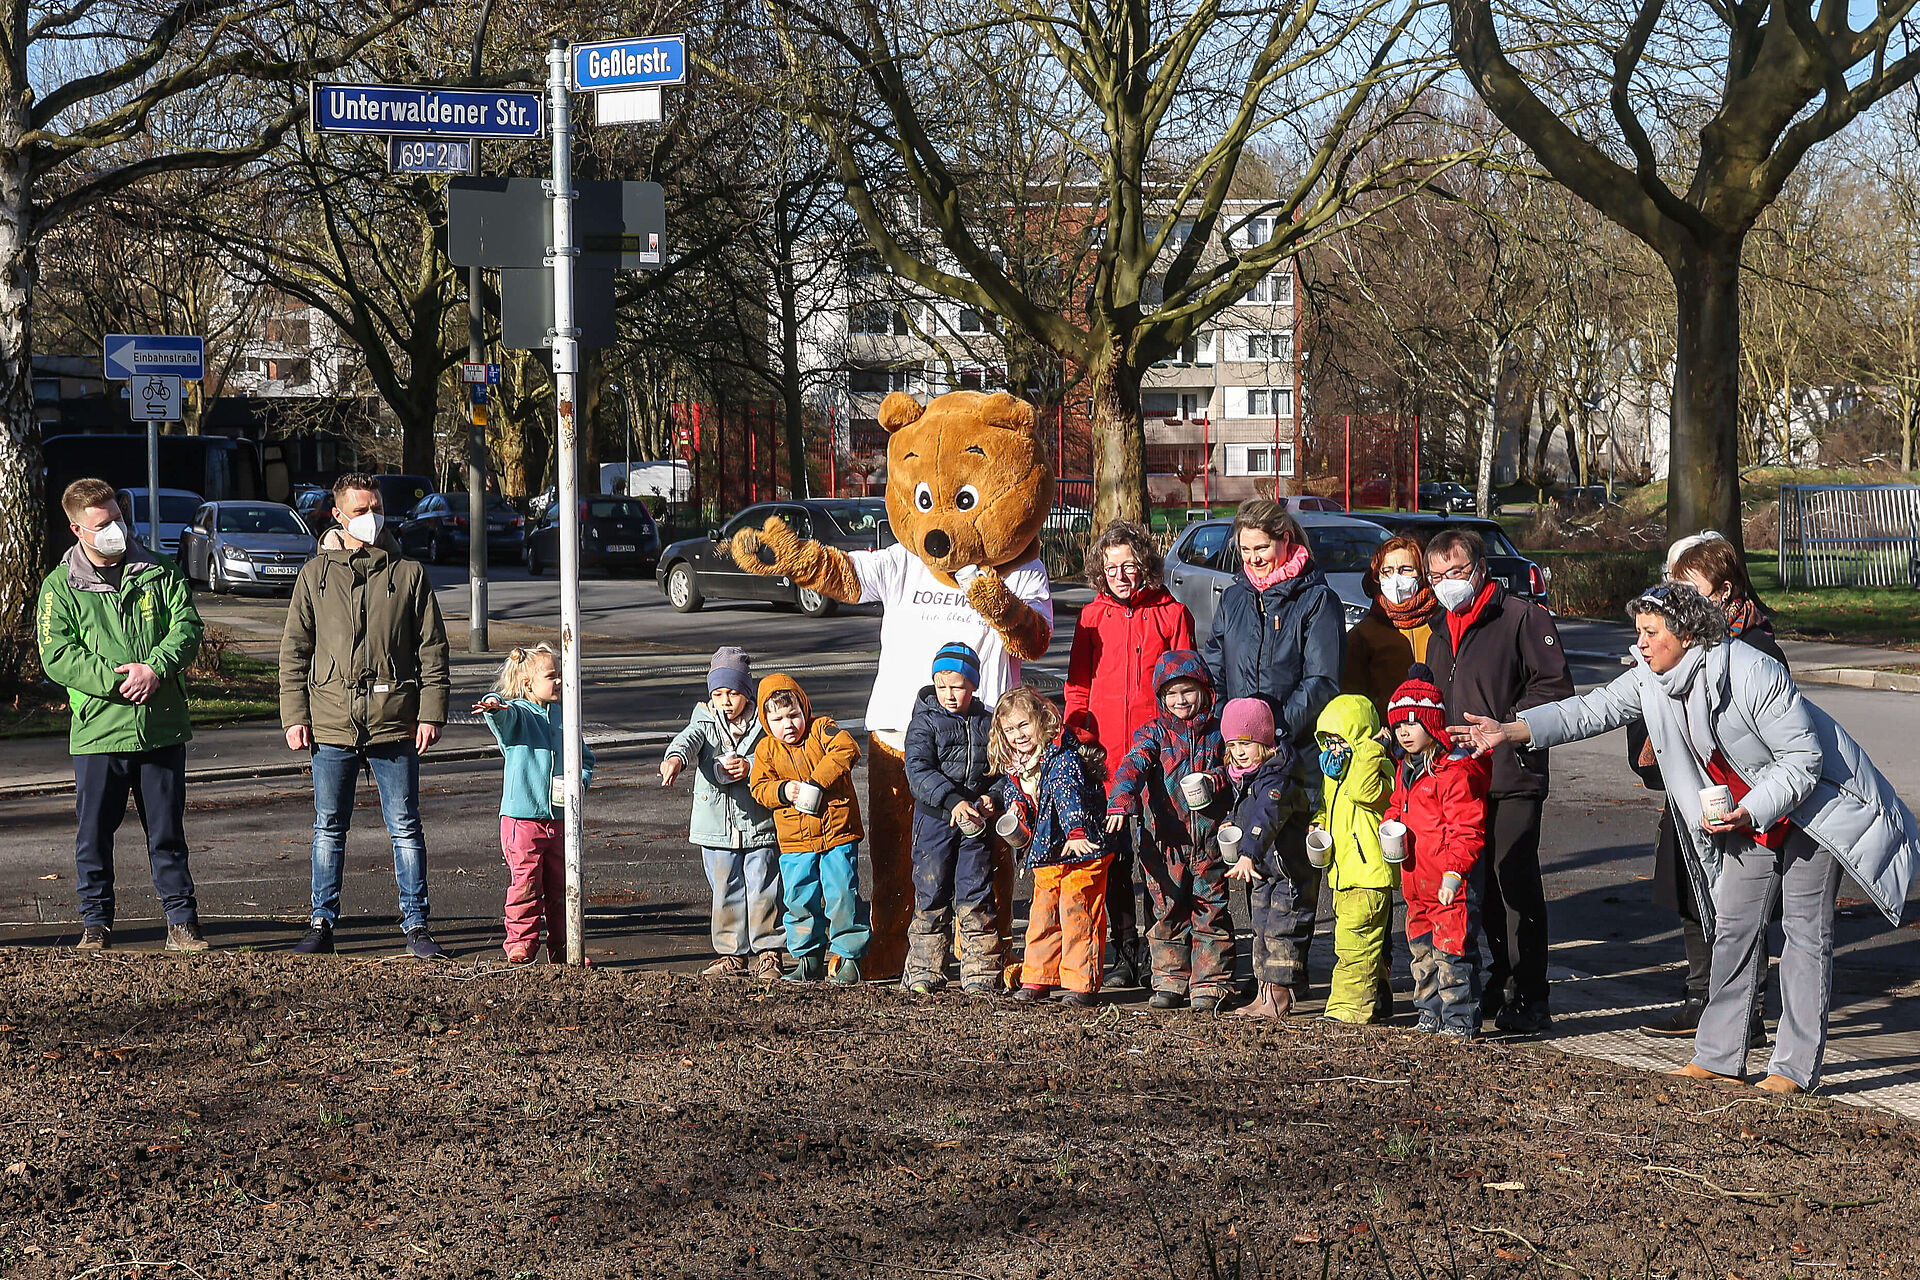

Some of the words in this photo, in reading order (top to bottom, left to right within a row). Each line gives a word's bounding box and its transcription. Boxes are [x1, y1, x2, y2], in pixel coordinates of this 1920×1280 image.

[588, 46, 672, 79] Geßlerstr.
[330, 91, 488, 126] Unterwaldener
[496, 98, 531, 127] Str.
[133, 352, 198, 363] Einbahnstraße
